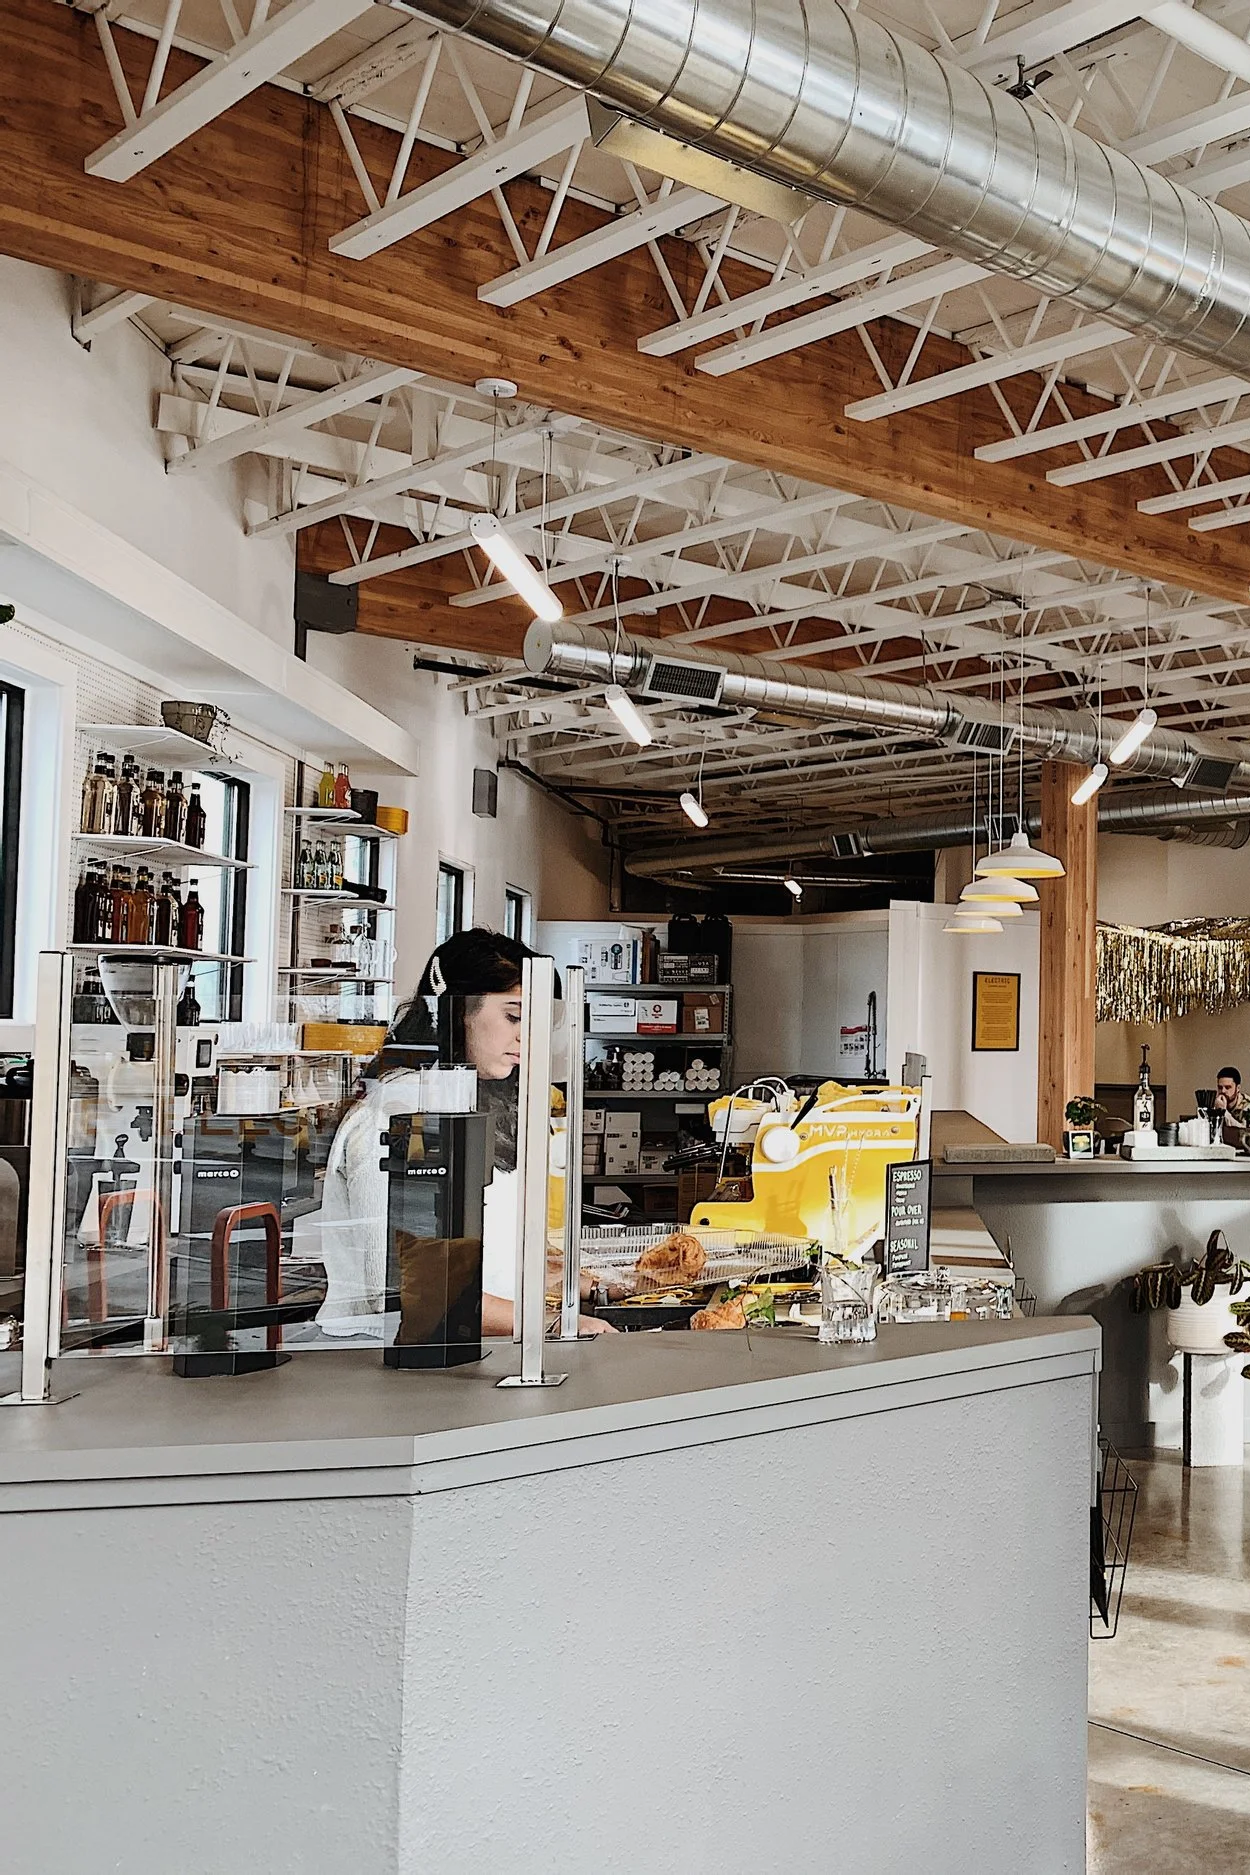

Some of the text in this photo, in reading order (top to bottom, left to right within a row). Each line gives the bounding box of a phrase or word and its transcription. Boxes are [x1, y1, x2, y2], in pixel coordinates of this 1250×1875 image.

[984, 977, 1011, 985] ELECTRIC
[809, 1124, 848, 1137] MVP
[893, 1170, 922, 1182] ESPRESSO
[891, 1204, 922, 1217] POUR OVER
[890, 1238, 919, 1253] SEASONAL
